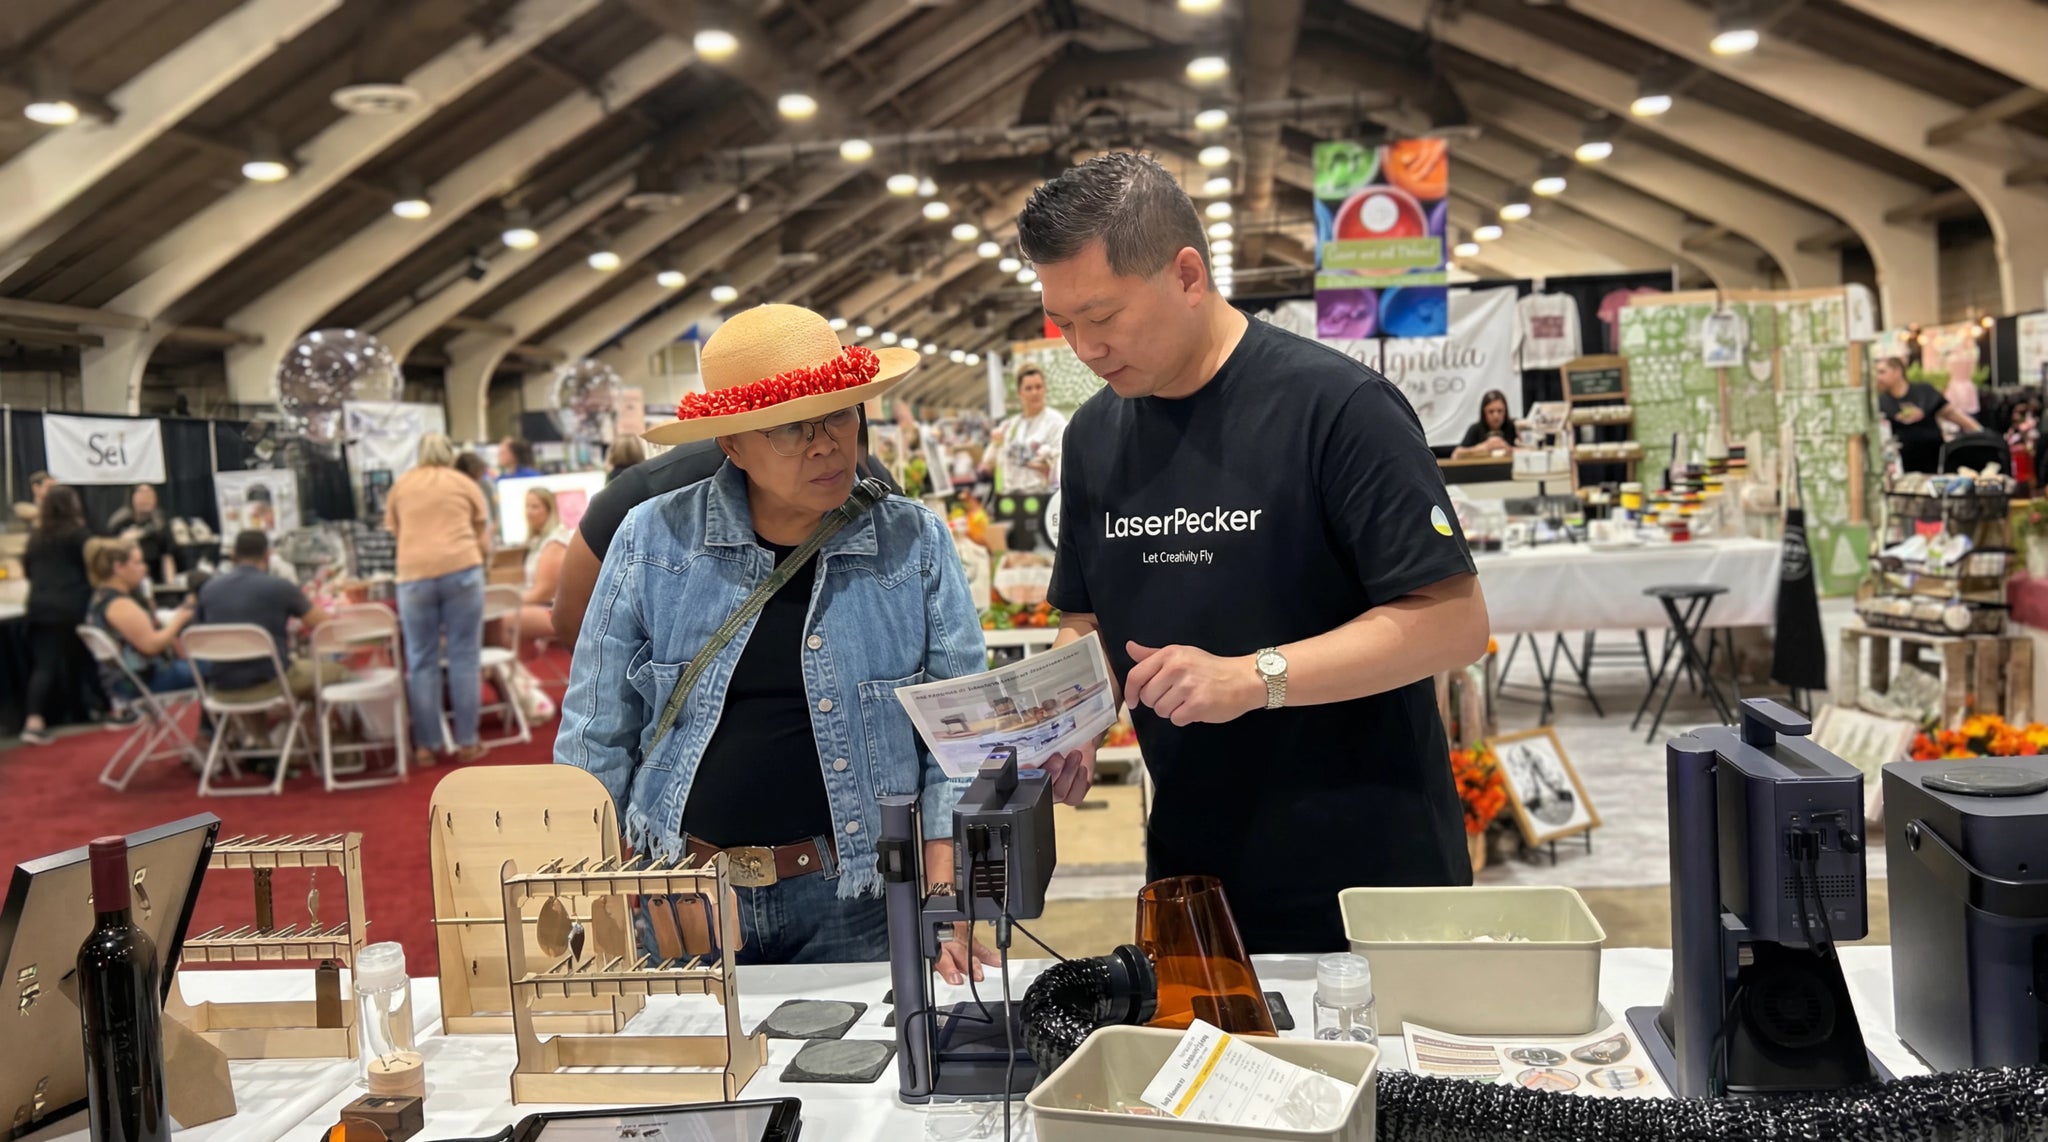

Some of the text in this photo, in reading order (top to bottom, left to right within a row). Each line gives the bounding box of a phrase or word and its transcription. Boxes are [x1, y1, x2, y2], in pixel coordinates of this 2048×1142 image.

[87, 431, 127, 467] Sei
[1105, 506, 1262, 538] LaserPecker
[1142, 549, 1214, 564] Let Creativity Fly
